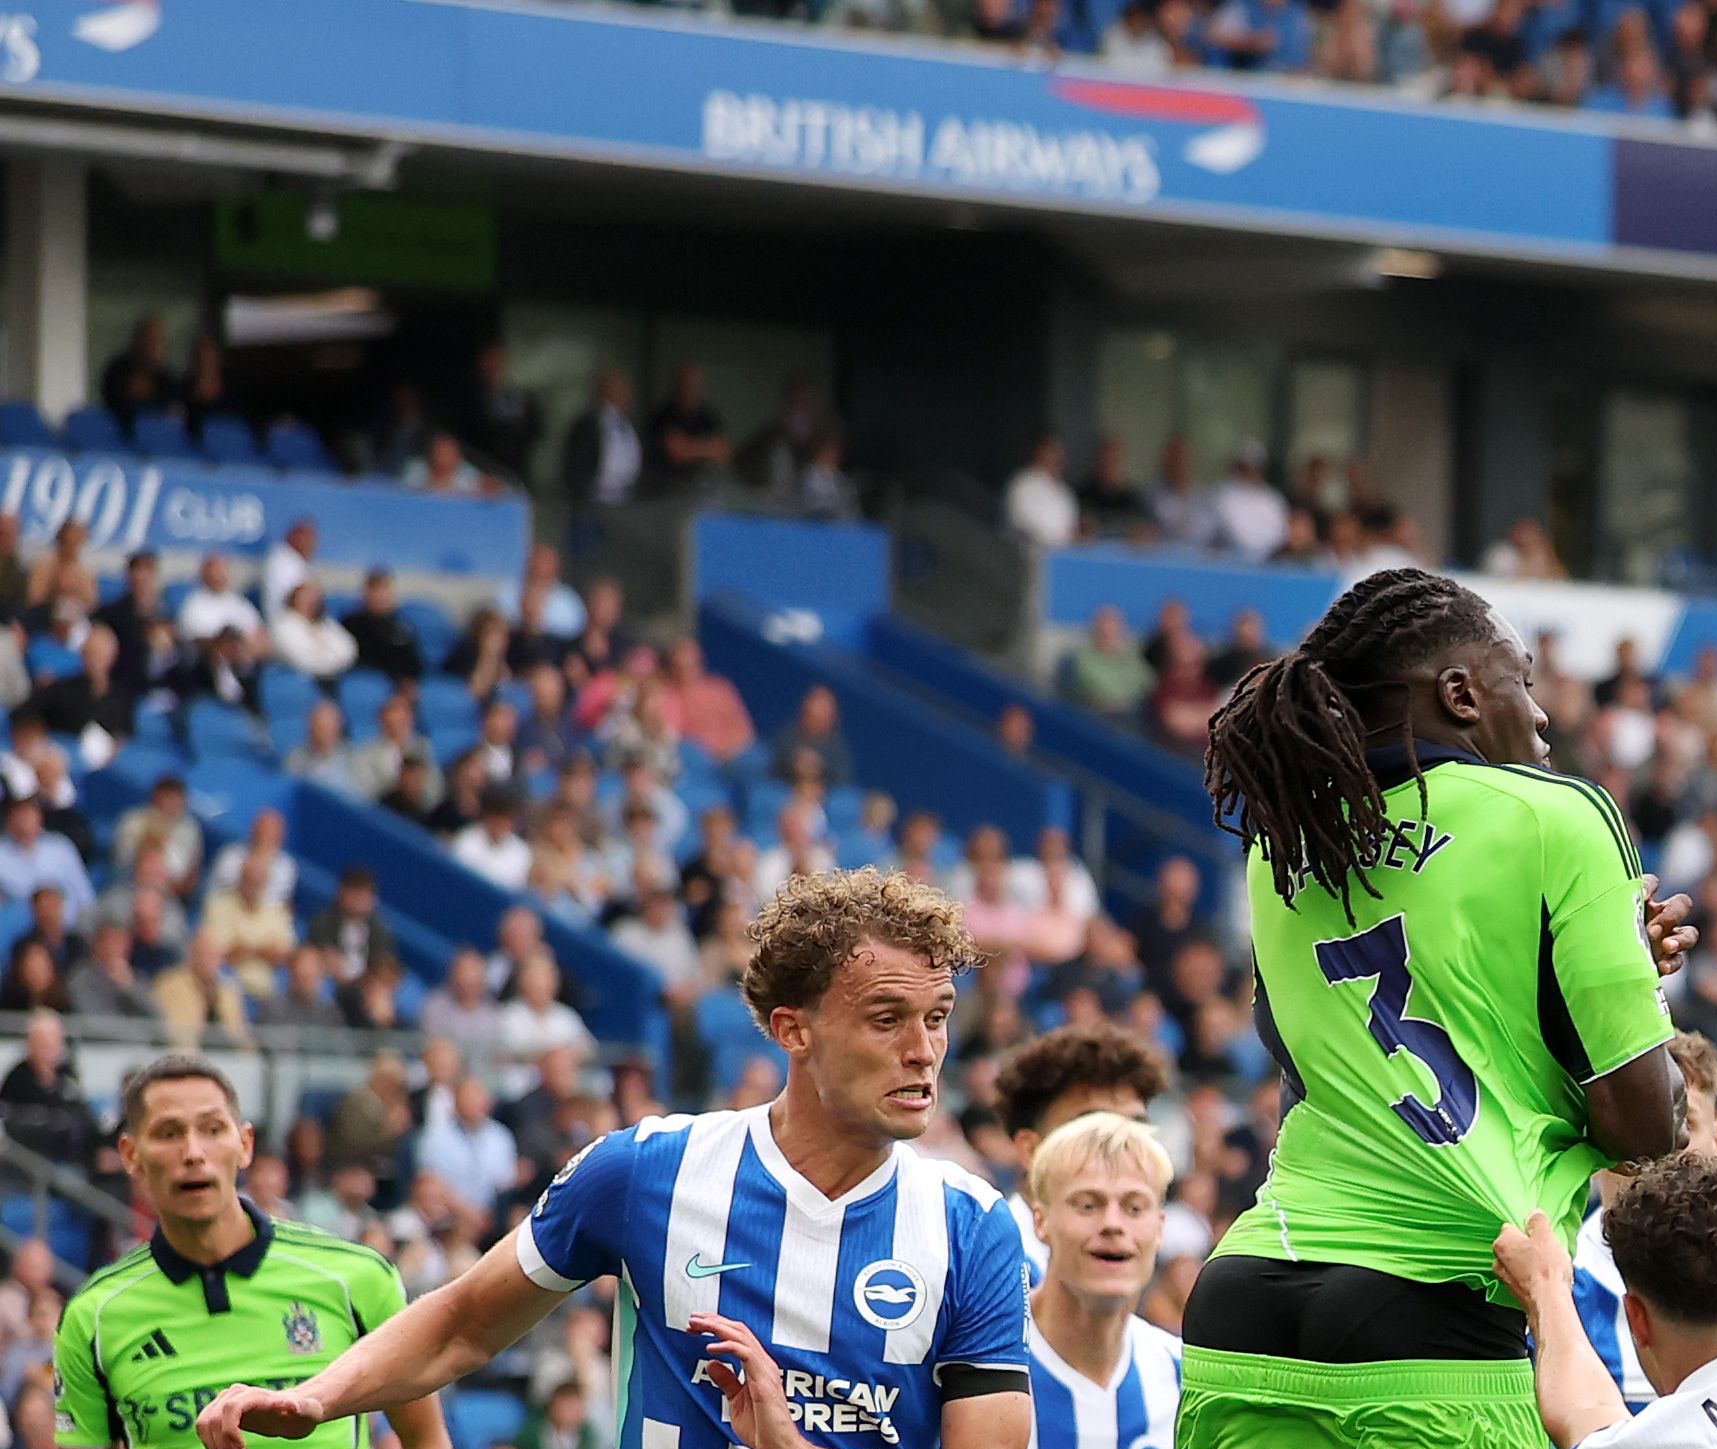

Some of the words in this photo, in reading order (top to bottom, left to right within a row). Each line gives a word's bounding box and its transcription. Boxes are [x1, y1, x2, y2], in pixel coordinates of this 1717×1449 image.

[703, 89, 926, 180] BRITISH
[927, 114, 1162, 204] AIRWAYS
[1312, 912, 1480, 1147] 3
